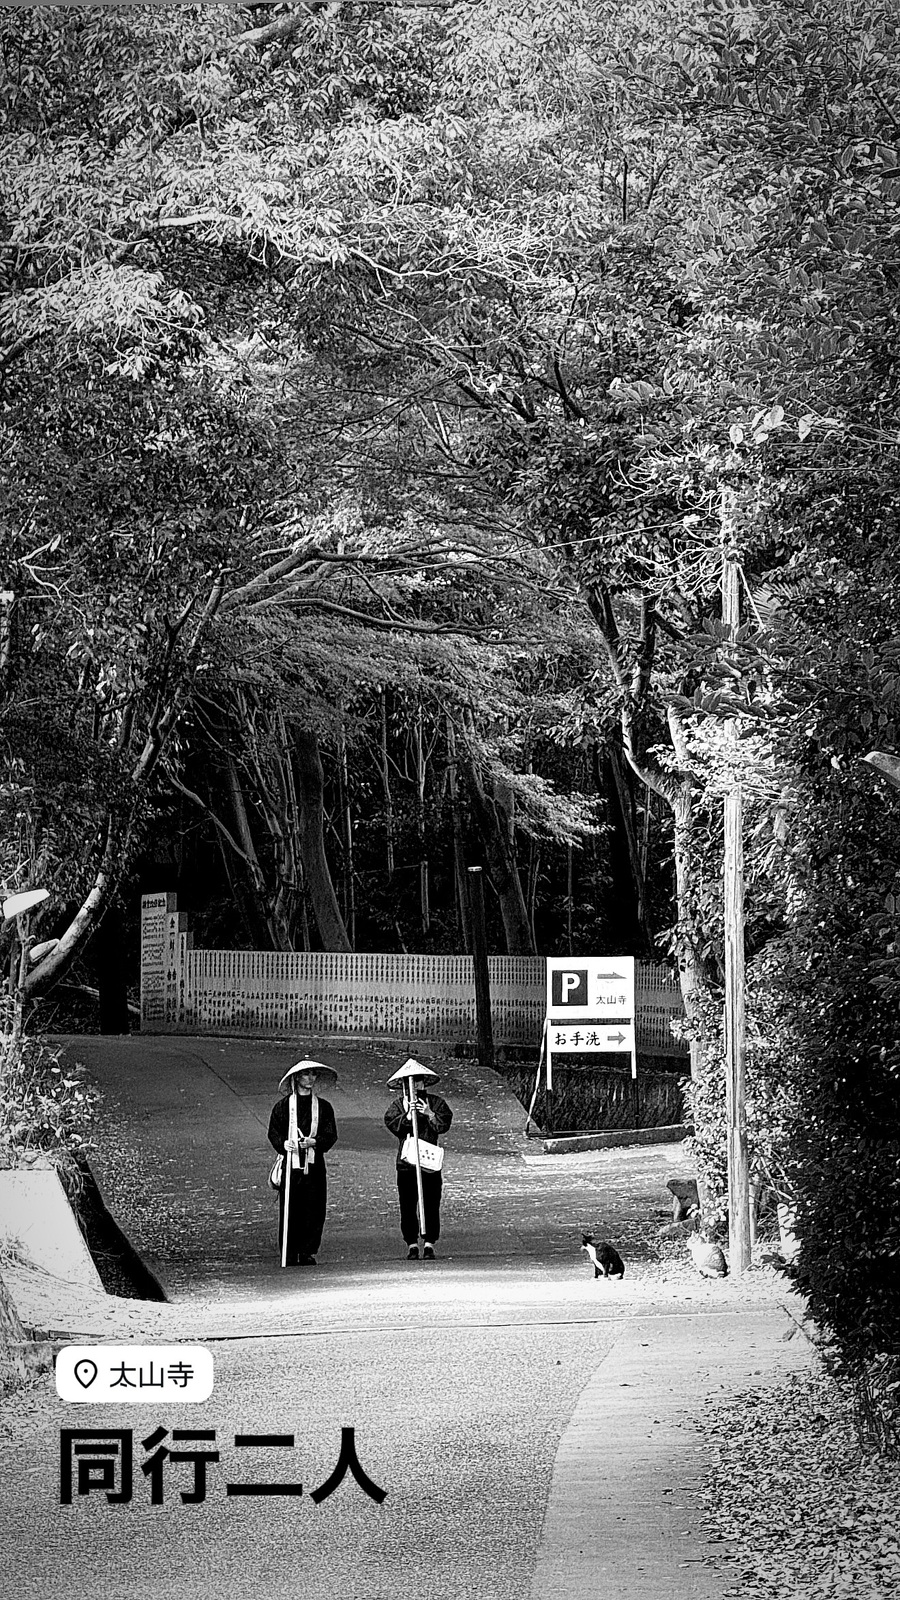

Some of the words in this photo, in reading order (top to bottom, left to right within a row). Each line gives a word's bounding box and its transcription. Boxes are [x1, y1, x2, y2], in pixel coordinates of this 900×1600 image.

[561, 972, 581, 1003] P
[596, 995, 627, 1005] 太山寺
[554, 1031, 601, 1046] お手洗
